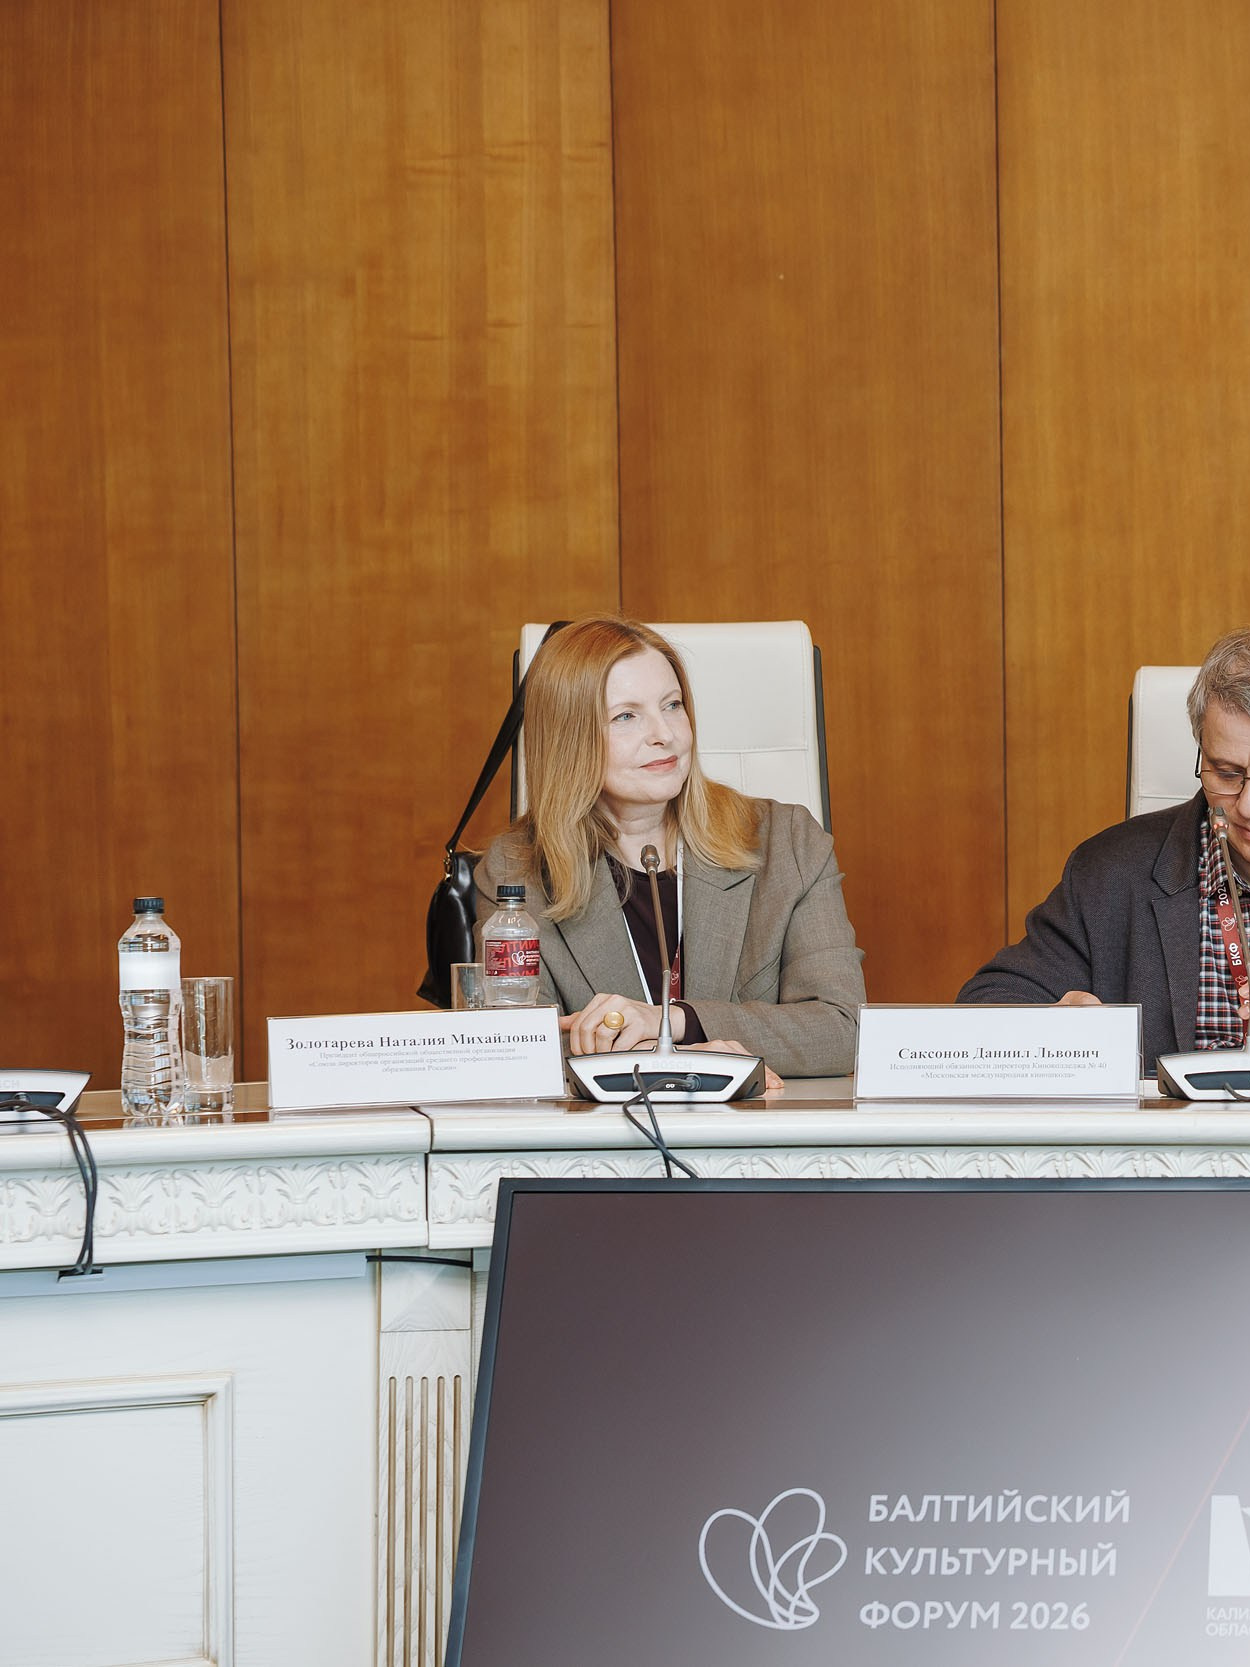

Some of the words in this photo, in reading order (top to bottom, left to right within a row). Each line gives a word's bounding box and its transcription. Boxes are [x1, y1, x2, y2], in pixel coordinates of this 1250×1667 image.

[1228, 942, 1242, 966] БКФ
[286, 1036, 374, 1051] Золотарева
[380, 1034, 446, 1049] Наталия
[451, 1032, 547, 1047] Михайловна
[898, 1047, 969, 1060] Саксонов
[973, 1047, 1030, 1061] Даниил
[1034, 1047, 1100, 1060] Львович
[890, 1062, 944, 1071] Исполняющий
[946, 1062, 990, 1070] обязанности
[1088, 1062, 1096, 1070] №
[920, 1072, 968, 1080] «Московская
[868, 1489, 1130, 1523] БАЛТИЙСКИЙ
[864, 1542, 1118, 1577] КУЛЬТУРНЫЙ
[859, 1600, 1000, 1630] ФОРУМ
[1009, 1602, 1091, 1631] 2026
